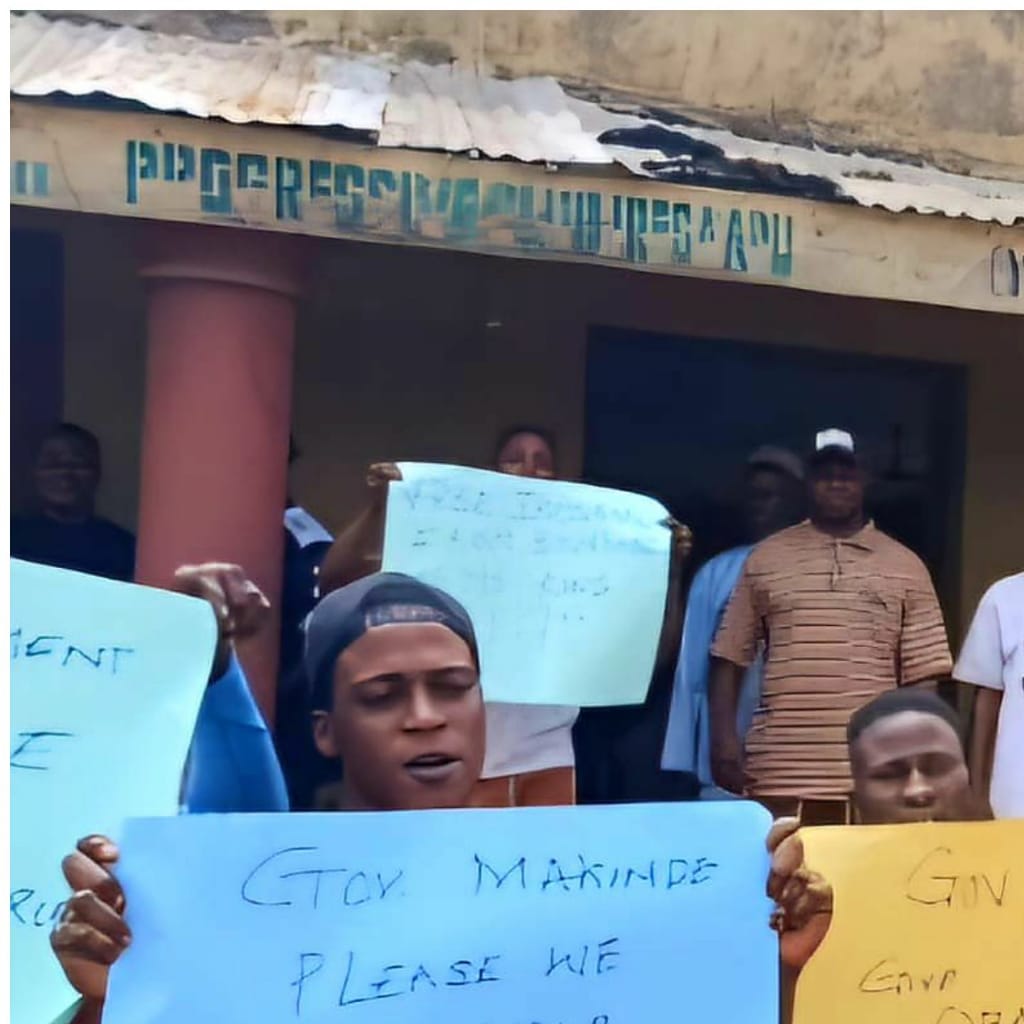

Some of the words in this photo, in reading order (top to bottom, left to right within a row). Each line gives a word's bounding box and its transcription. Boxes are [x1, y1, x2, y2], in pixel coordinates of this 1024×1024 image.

[474, 853, 720, 895] MAKINDE
[290, 951, 502, 1015] PLEASE
[545, 938, 622, 976] WE
